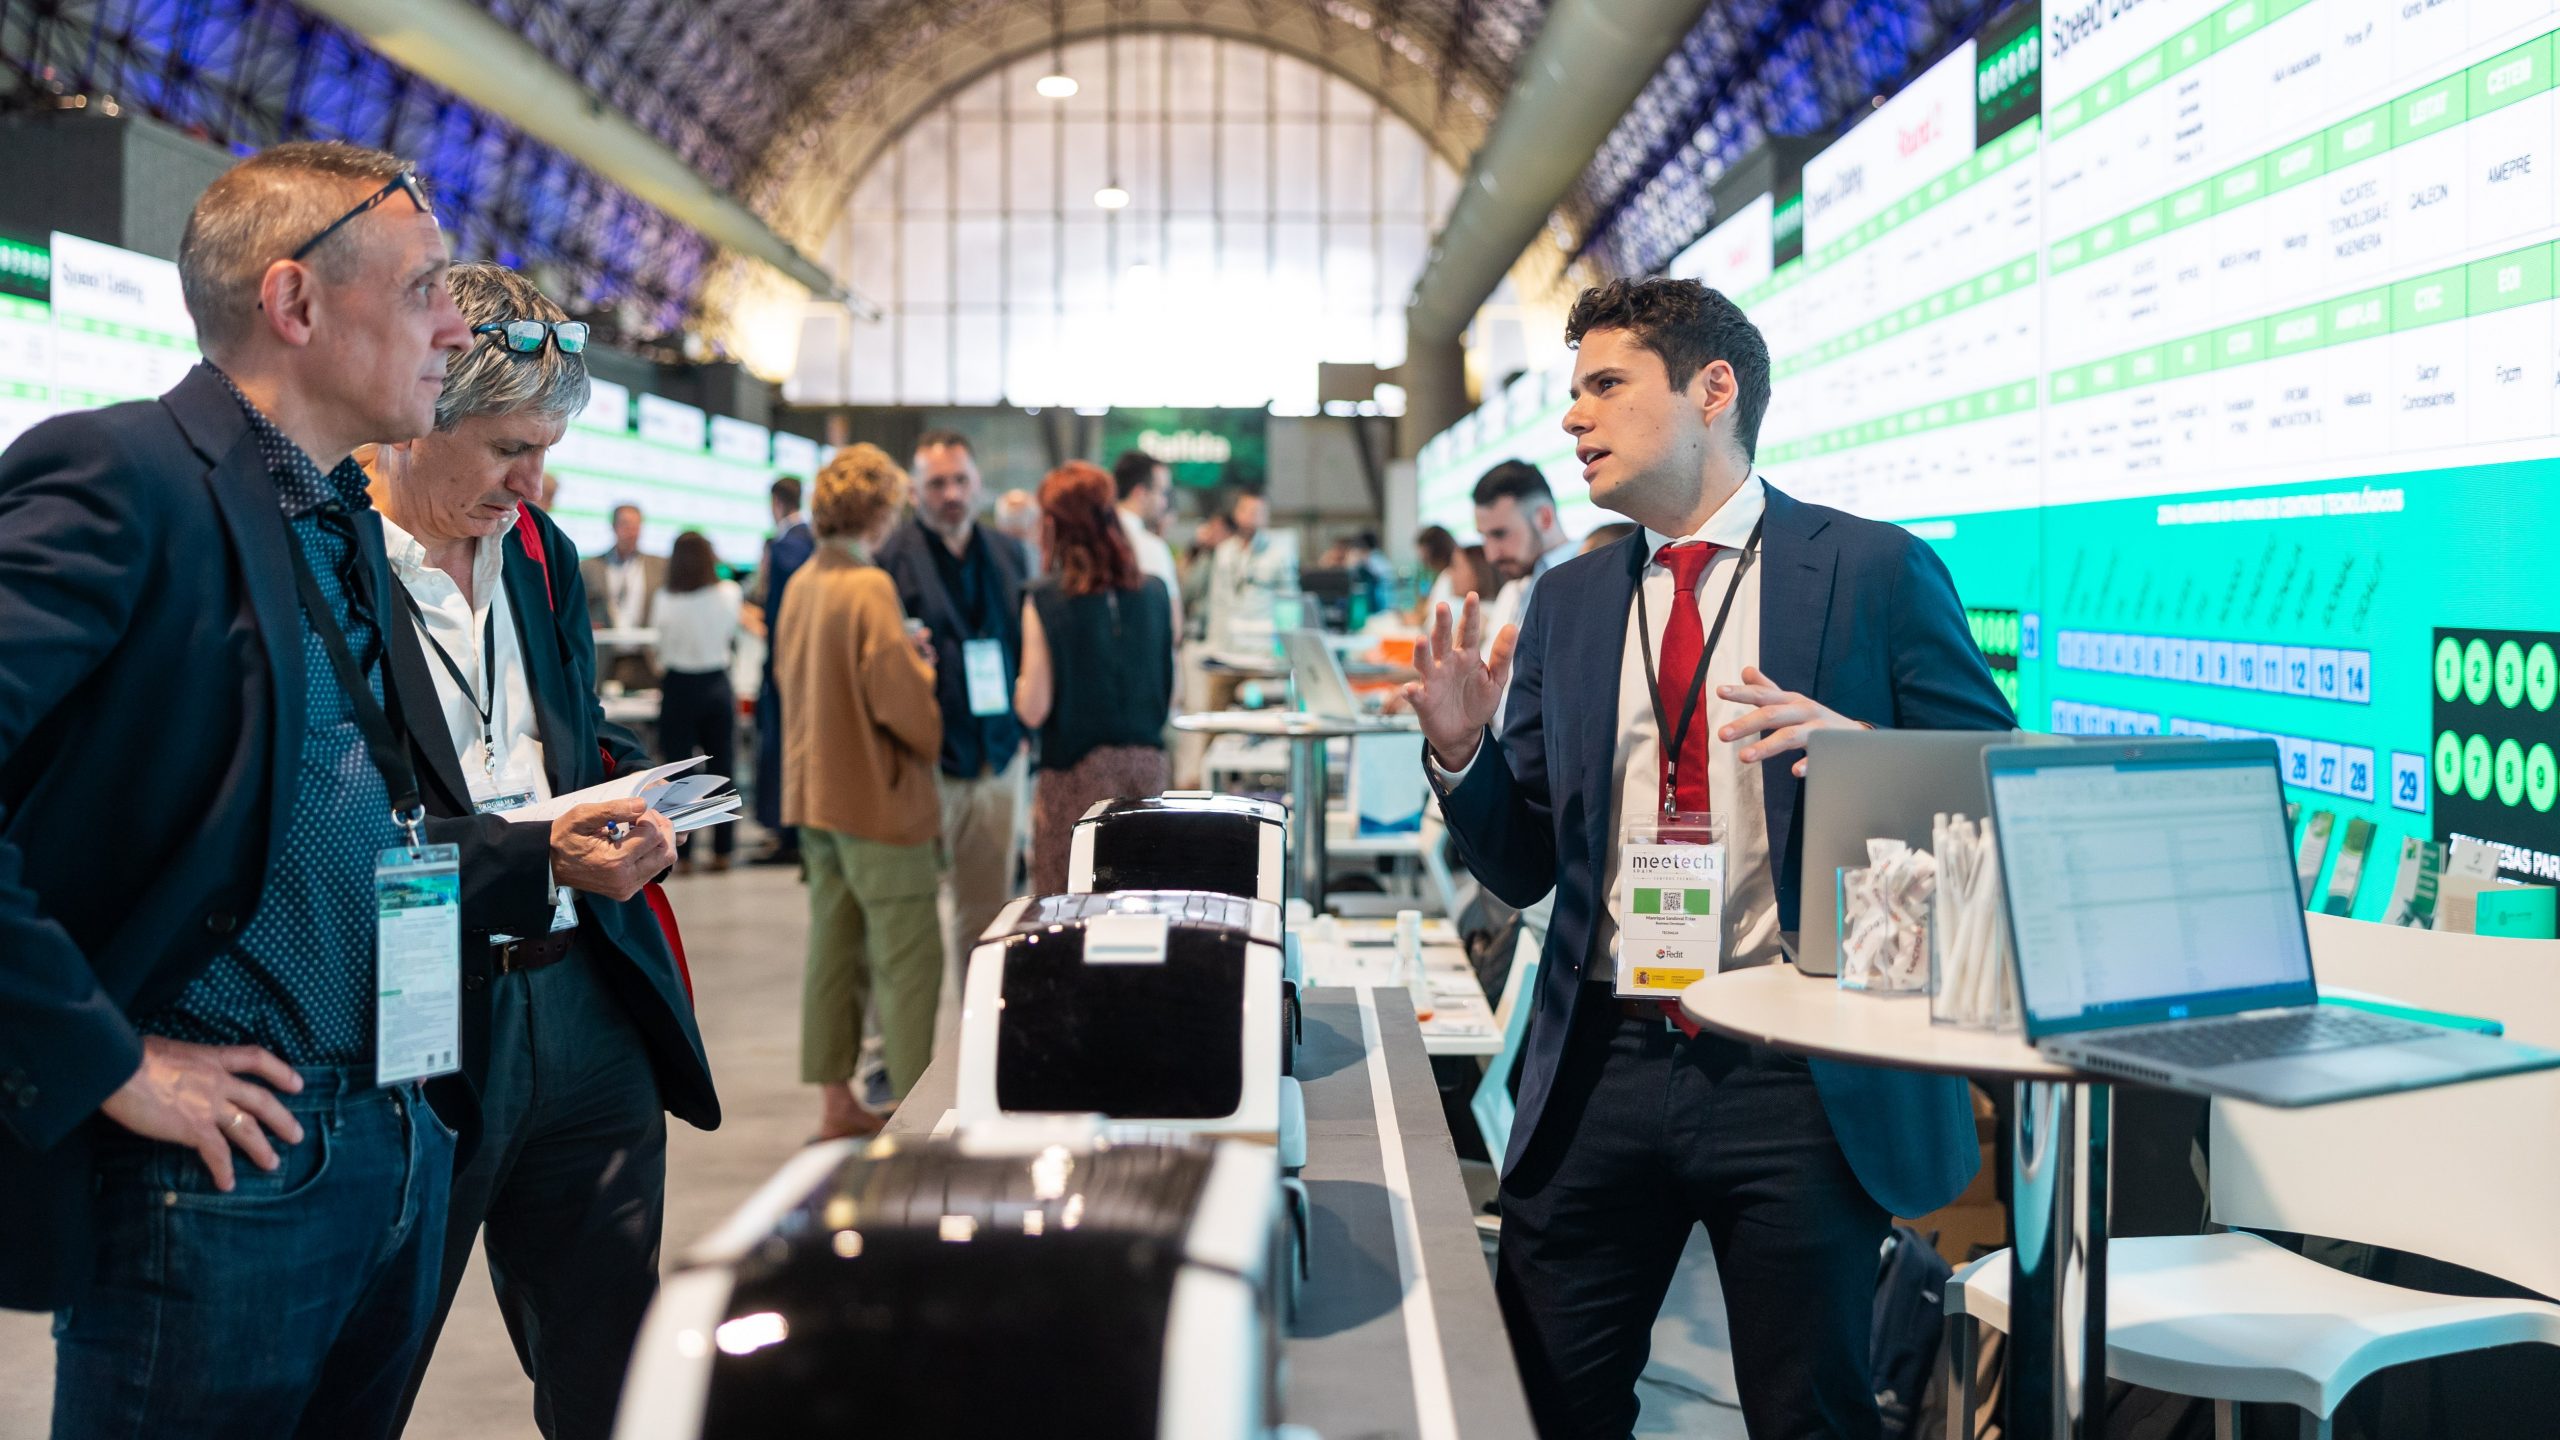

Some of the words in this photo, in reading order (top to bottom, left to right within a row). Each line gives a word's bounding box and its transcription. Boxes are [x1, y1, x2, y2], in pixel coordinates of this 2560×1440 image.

[2487, 154, 2533, 183] AMEPRE
[2240, 657, 2252, 683] 10
[2265, 660, 2276, 686] 11
[2291, 662, 2305, 688] 12
[2319, 664, 2333, 692] 13
[2348, 666, 2364, 694] 14
[2444, 658, 2452, 680] 1
[2473, 660, 2481, 683] 2
[2505, 662, 2514, 686] 3
[2536, 664, 2546, 689] 4
[2320, 757, 2336, 785] 27
[2351, 762, 2367, 792] 28
[2399, 770, 2418, 802] 29
[2473, 755, 2481, 779] 7
[2505, 760, 2514, 785] 8
[2536, 765, 2545, 790] 9
[478, 798, 516, 810] PROGRAMA
[1632, 853, 1714, 869] meetech
[1666, 950, 1684, 959] Fedit
